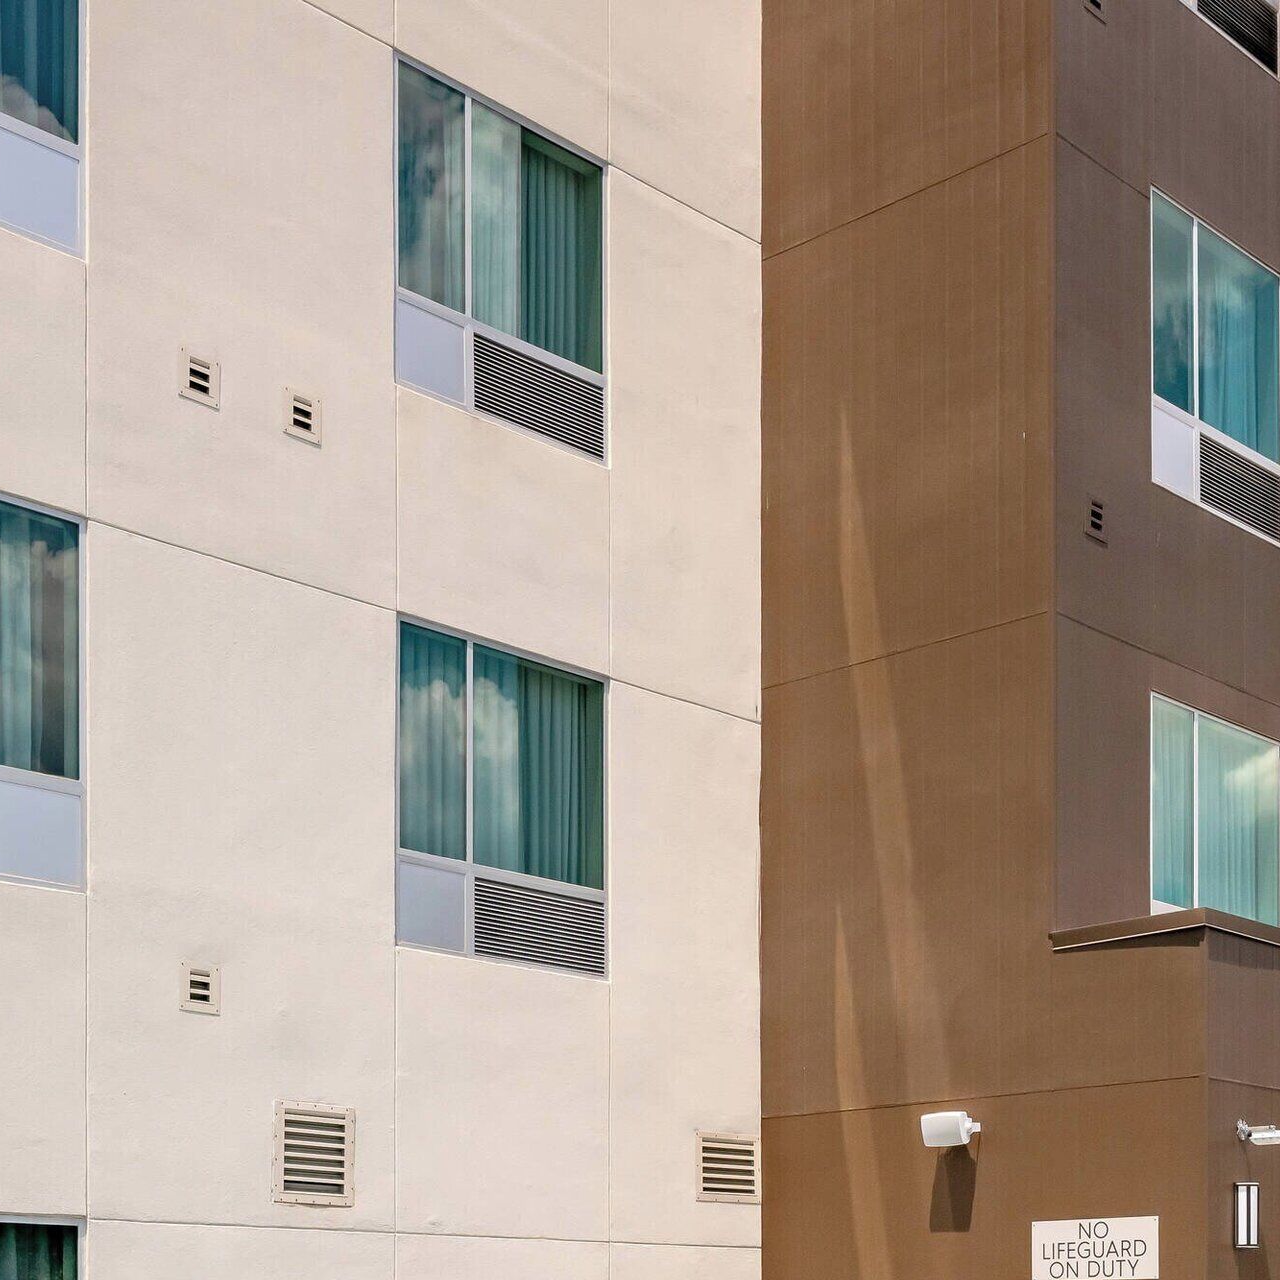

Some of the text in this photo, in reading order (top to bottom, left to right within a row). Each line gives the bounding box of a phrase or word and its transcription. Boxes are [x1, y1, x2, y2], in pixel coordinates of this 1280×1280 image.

[1078, 1221, 1109, 1239] NO
[1042, 1239, 1147, 1260] LIFEGUARD
[1049, 1259, 1139, 1279] ON DUTY
